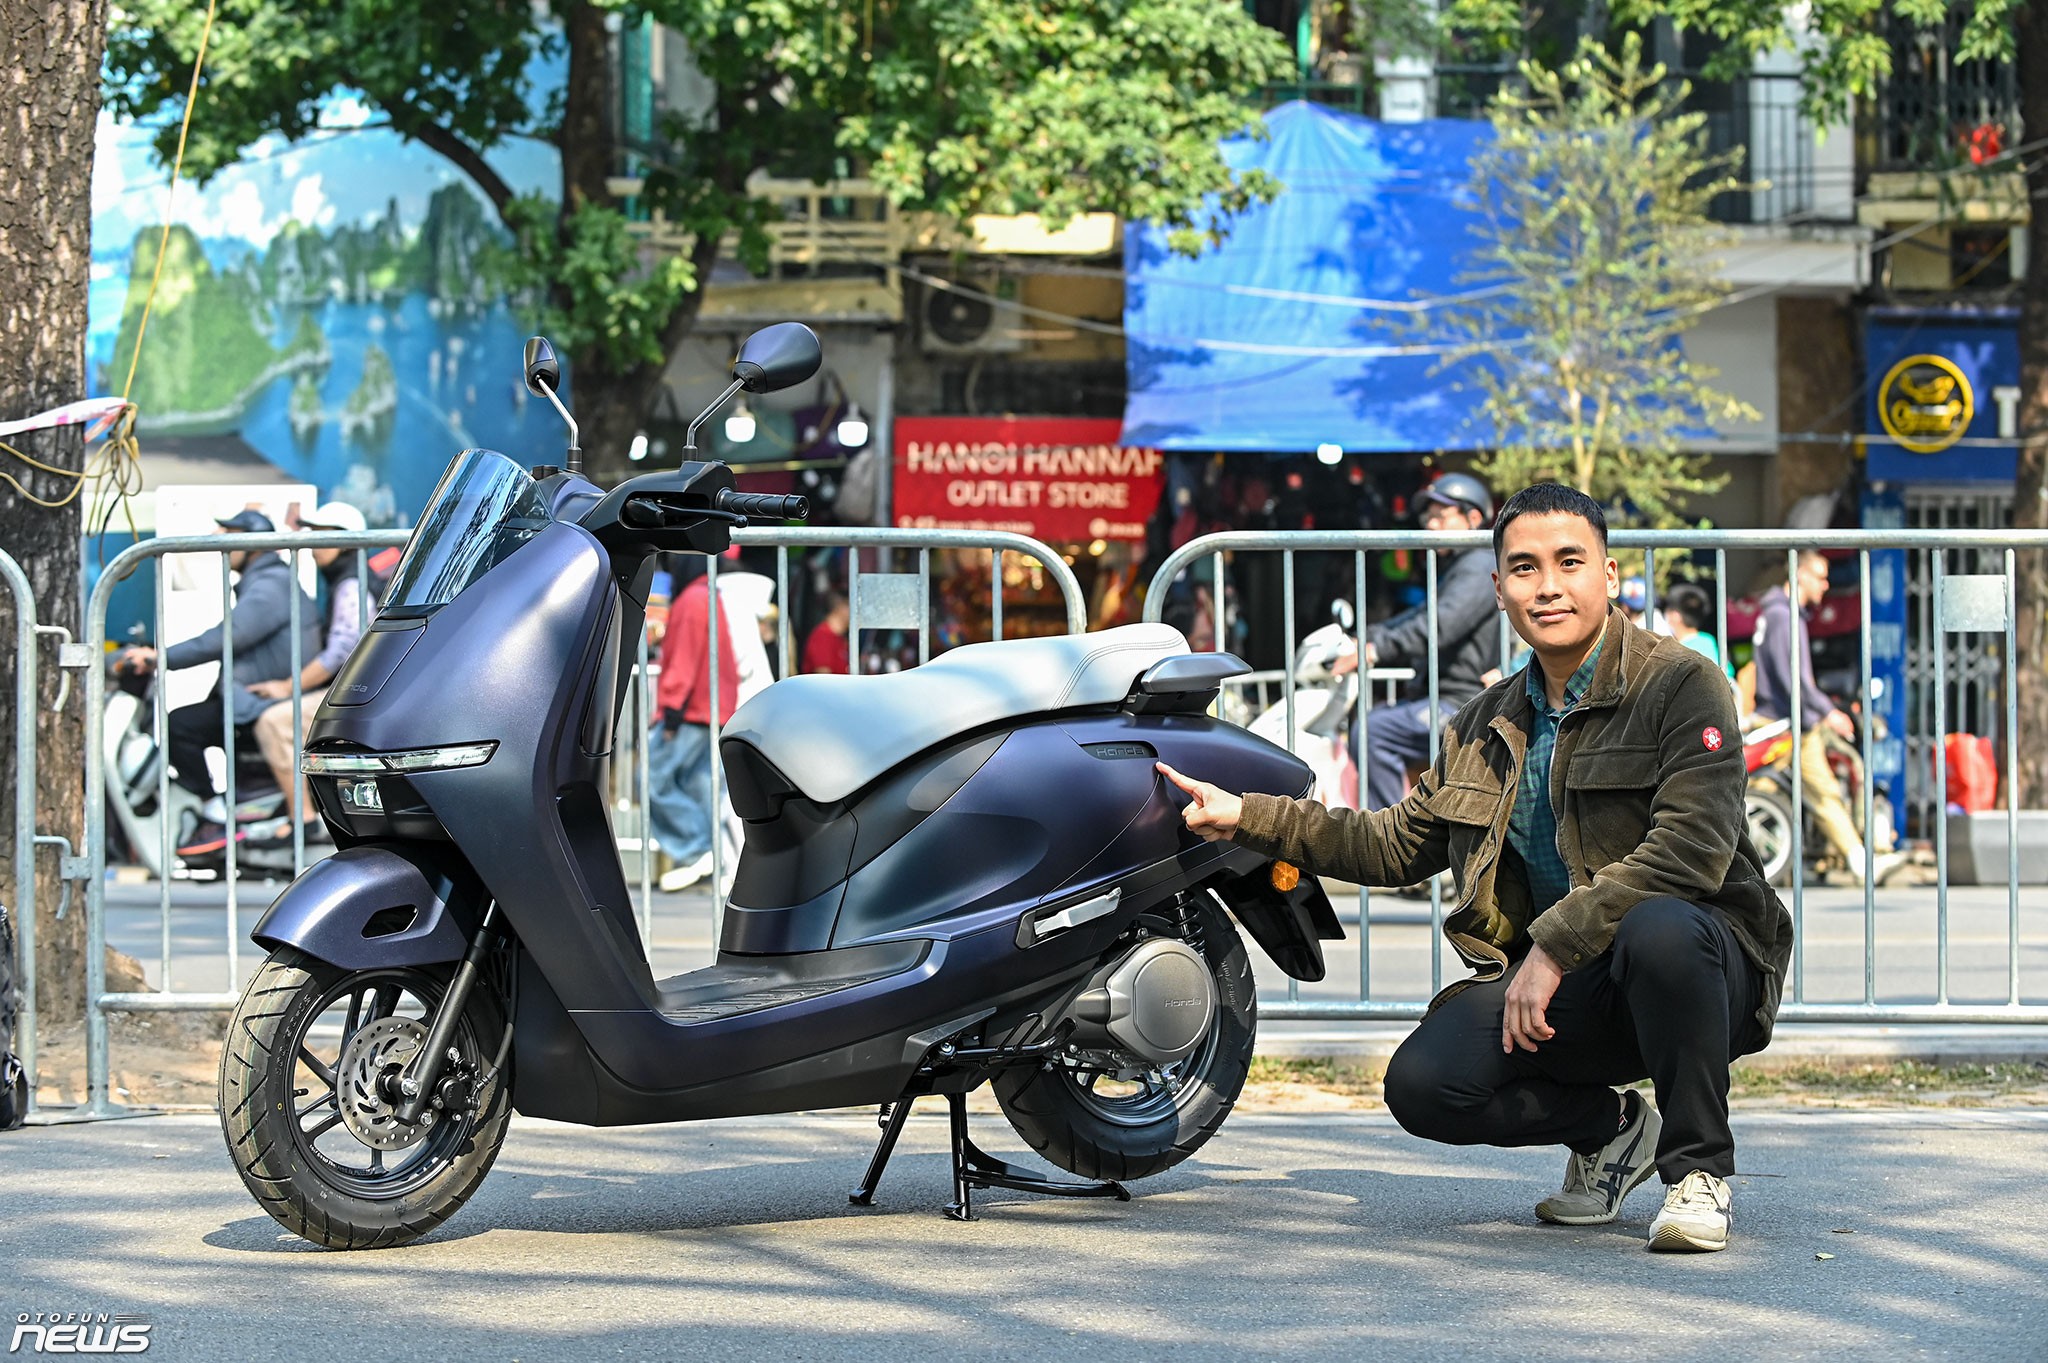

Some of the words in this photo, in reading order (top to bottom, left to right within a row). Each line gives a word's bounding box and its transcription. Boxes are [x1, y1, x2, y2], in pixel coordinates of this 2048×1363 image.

[907, 441, 1017, 475] HANOI
[947, 480, 1043, 507] OUTLET
[1048, 482, 1129, 508] STORE
[1096, 747, 1144, 757] Honda
[1164, 998, 1202, 1008] Honda
